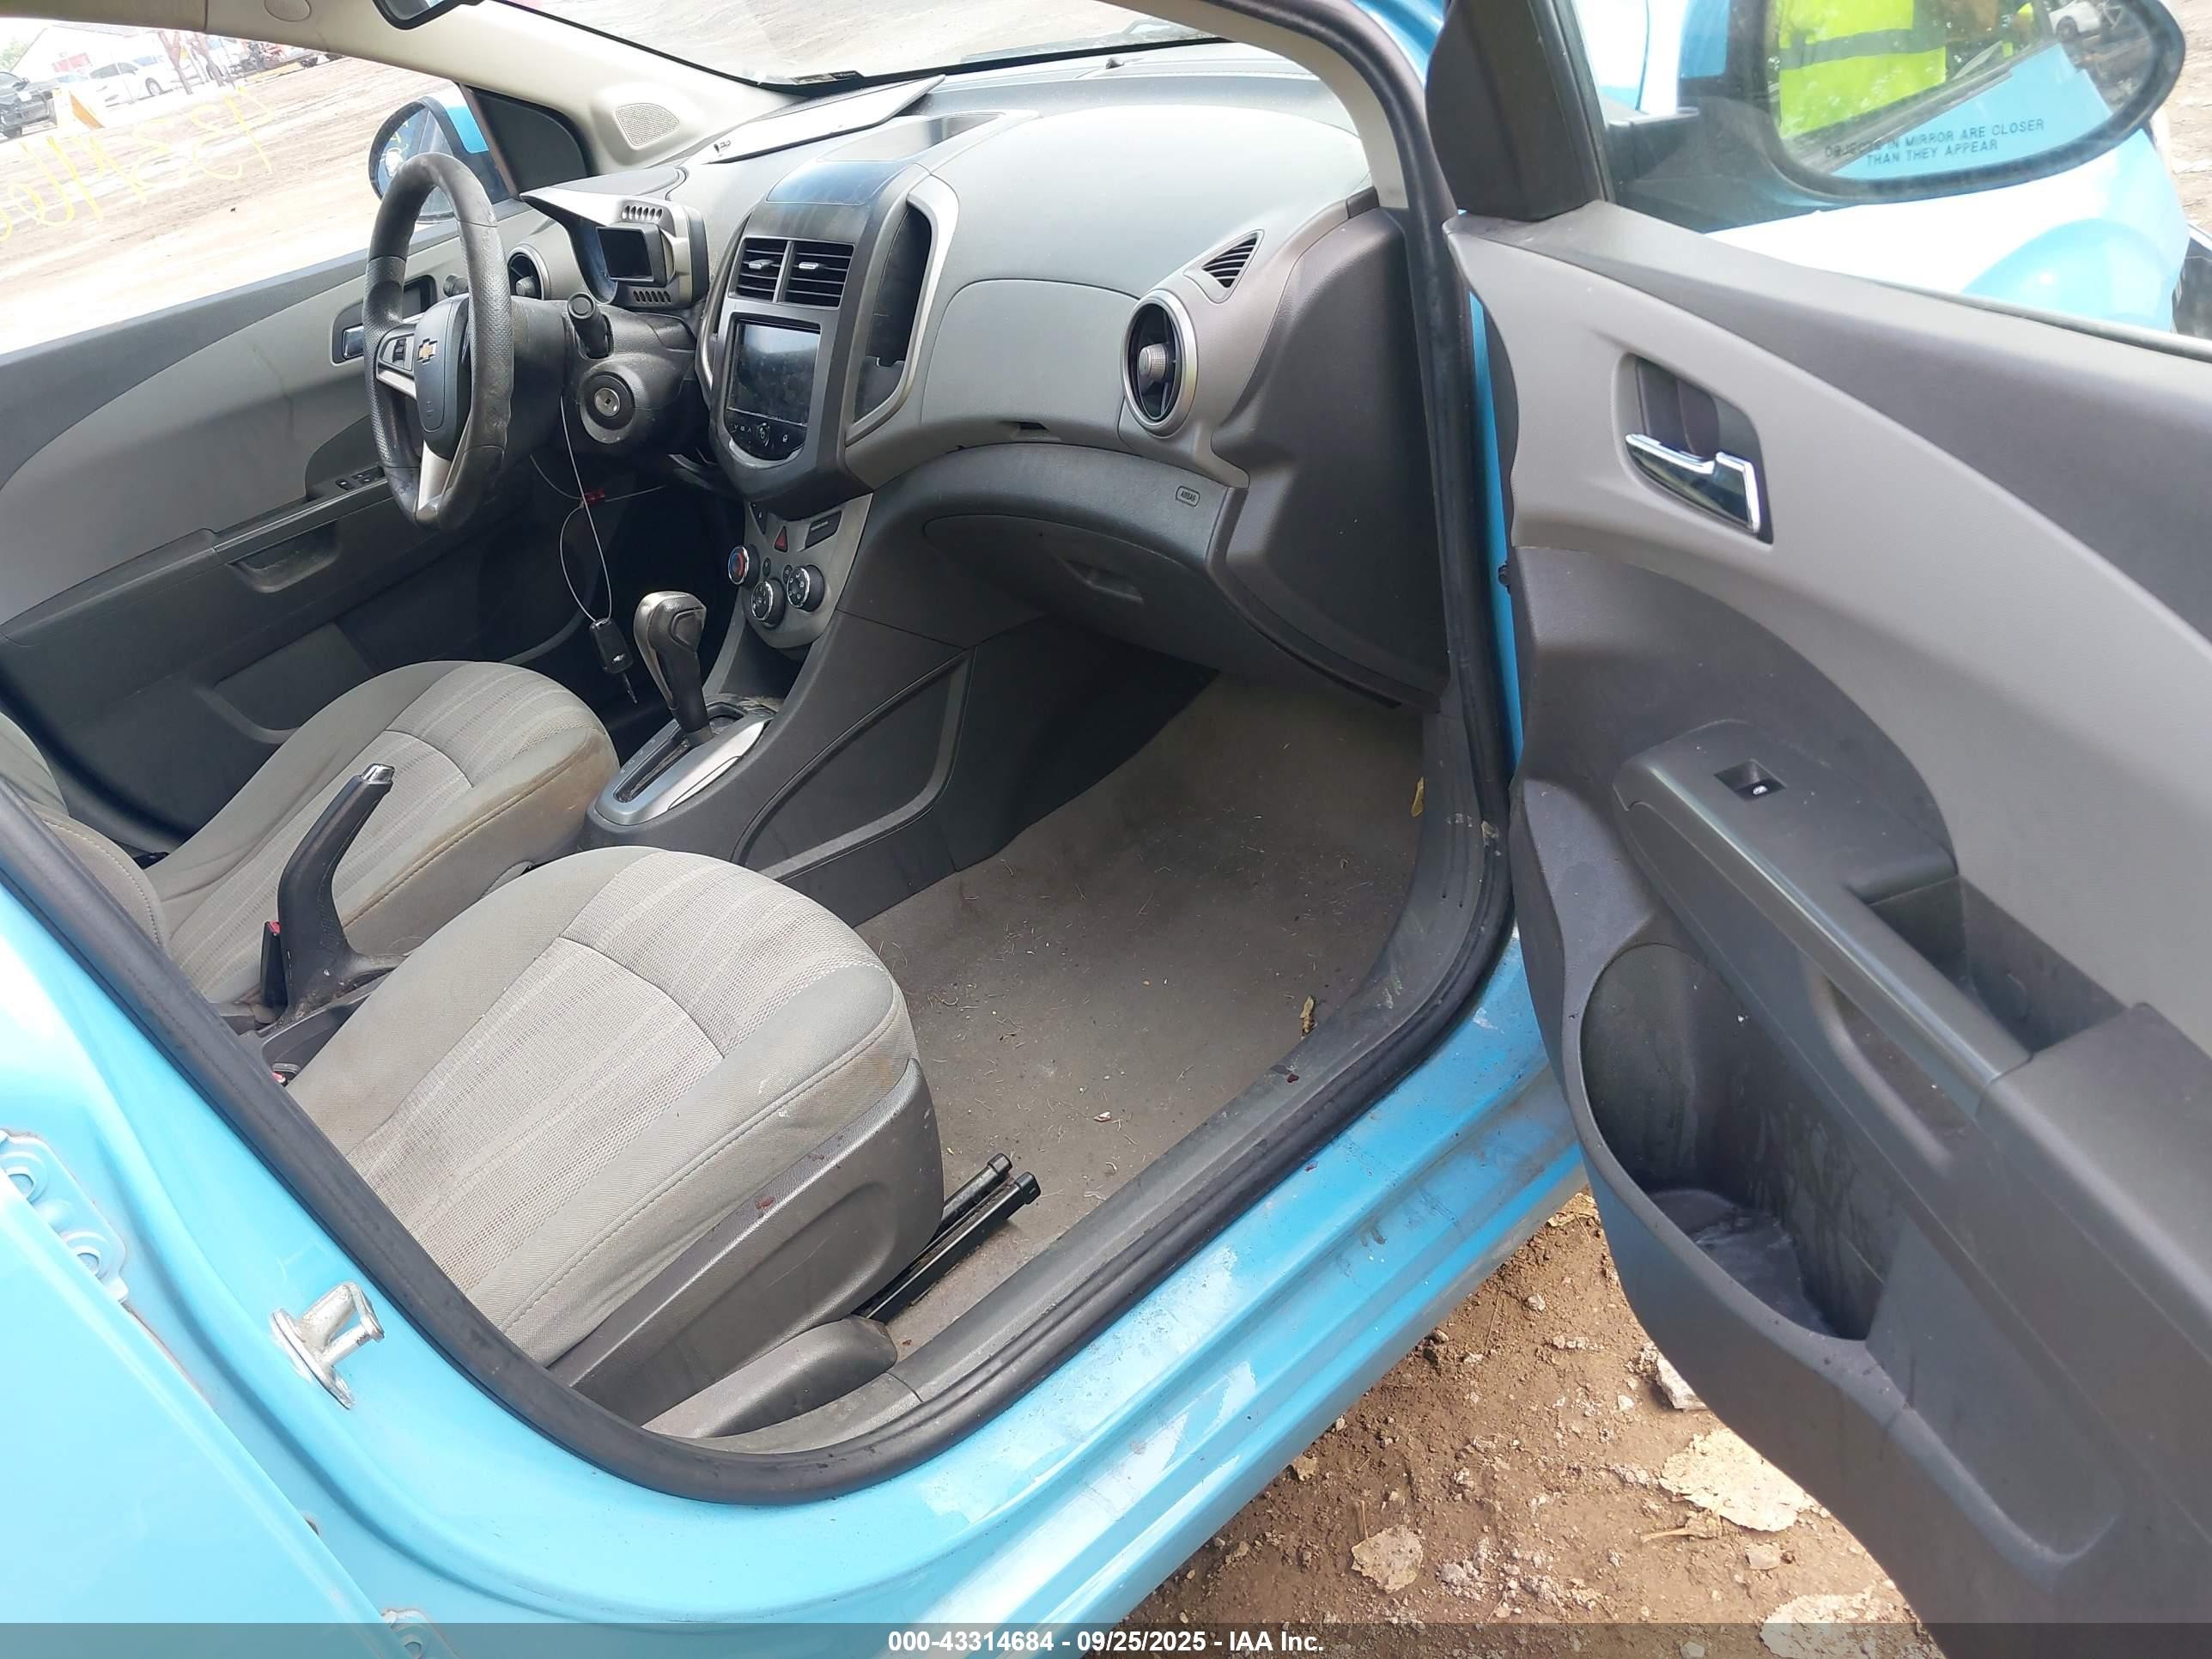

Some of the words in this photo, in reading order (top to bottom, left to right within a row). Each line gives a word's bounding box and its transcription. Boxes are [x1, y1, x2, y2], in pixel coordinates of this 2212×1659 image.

[1887, 138, 1899, 150] IN
[1905, 131, 1954, 147] MIRROR
[1960, 126, 1986, 139] ARE
[1991, 118, 2045, 136] CLOSER
[1867, 149, 1900, 167] THAN
[1905, 146, 1937, 161] THEY
[1944, 139, 1999, 157] APPEAR
